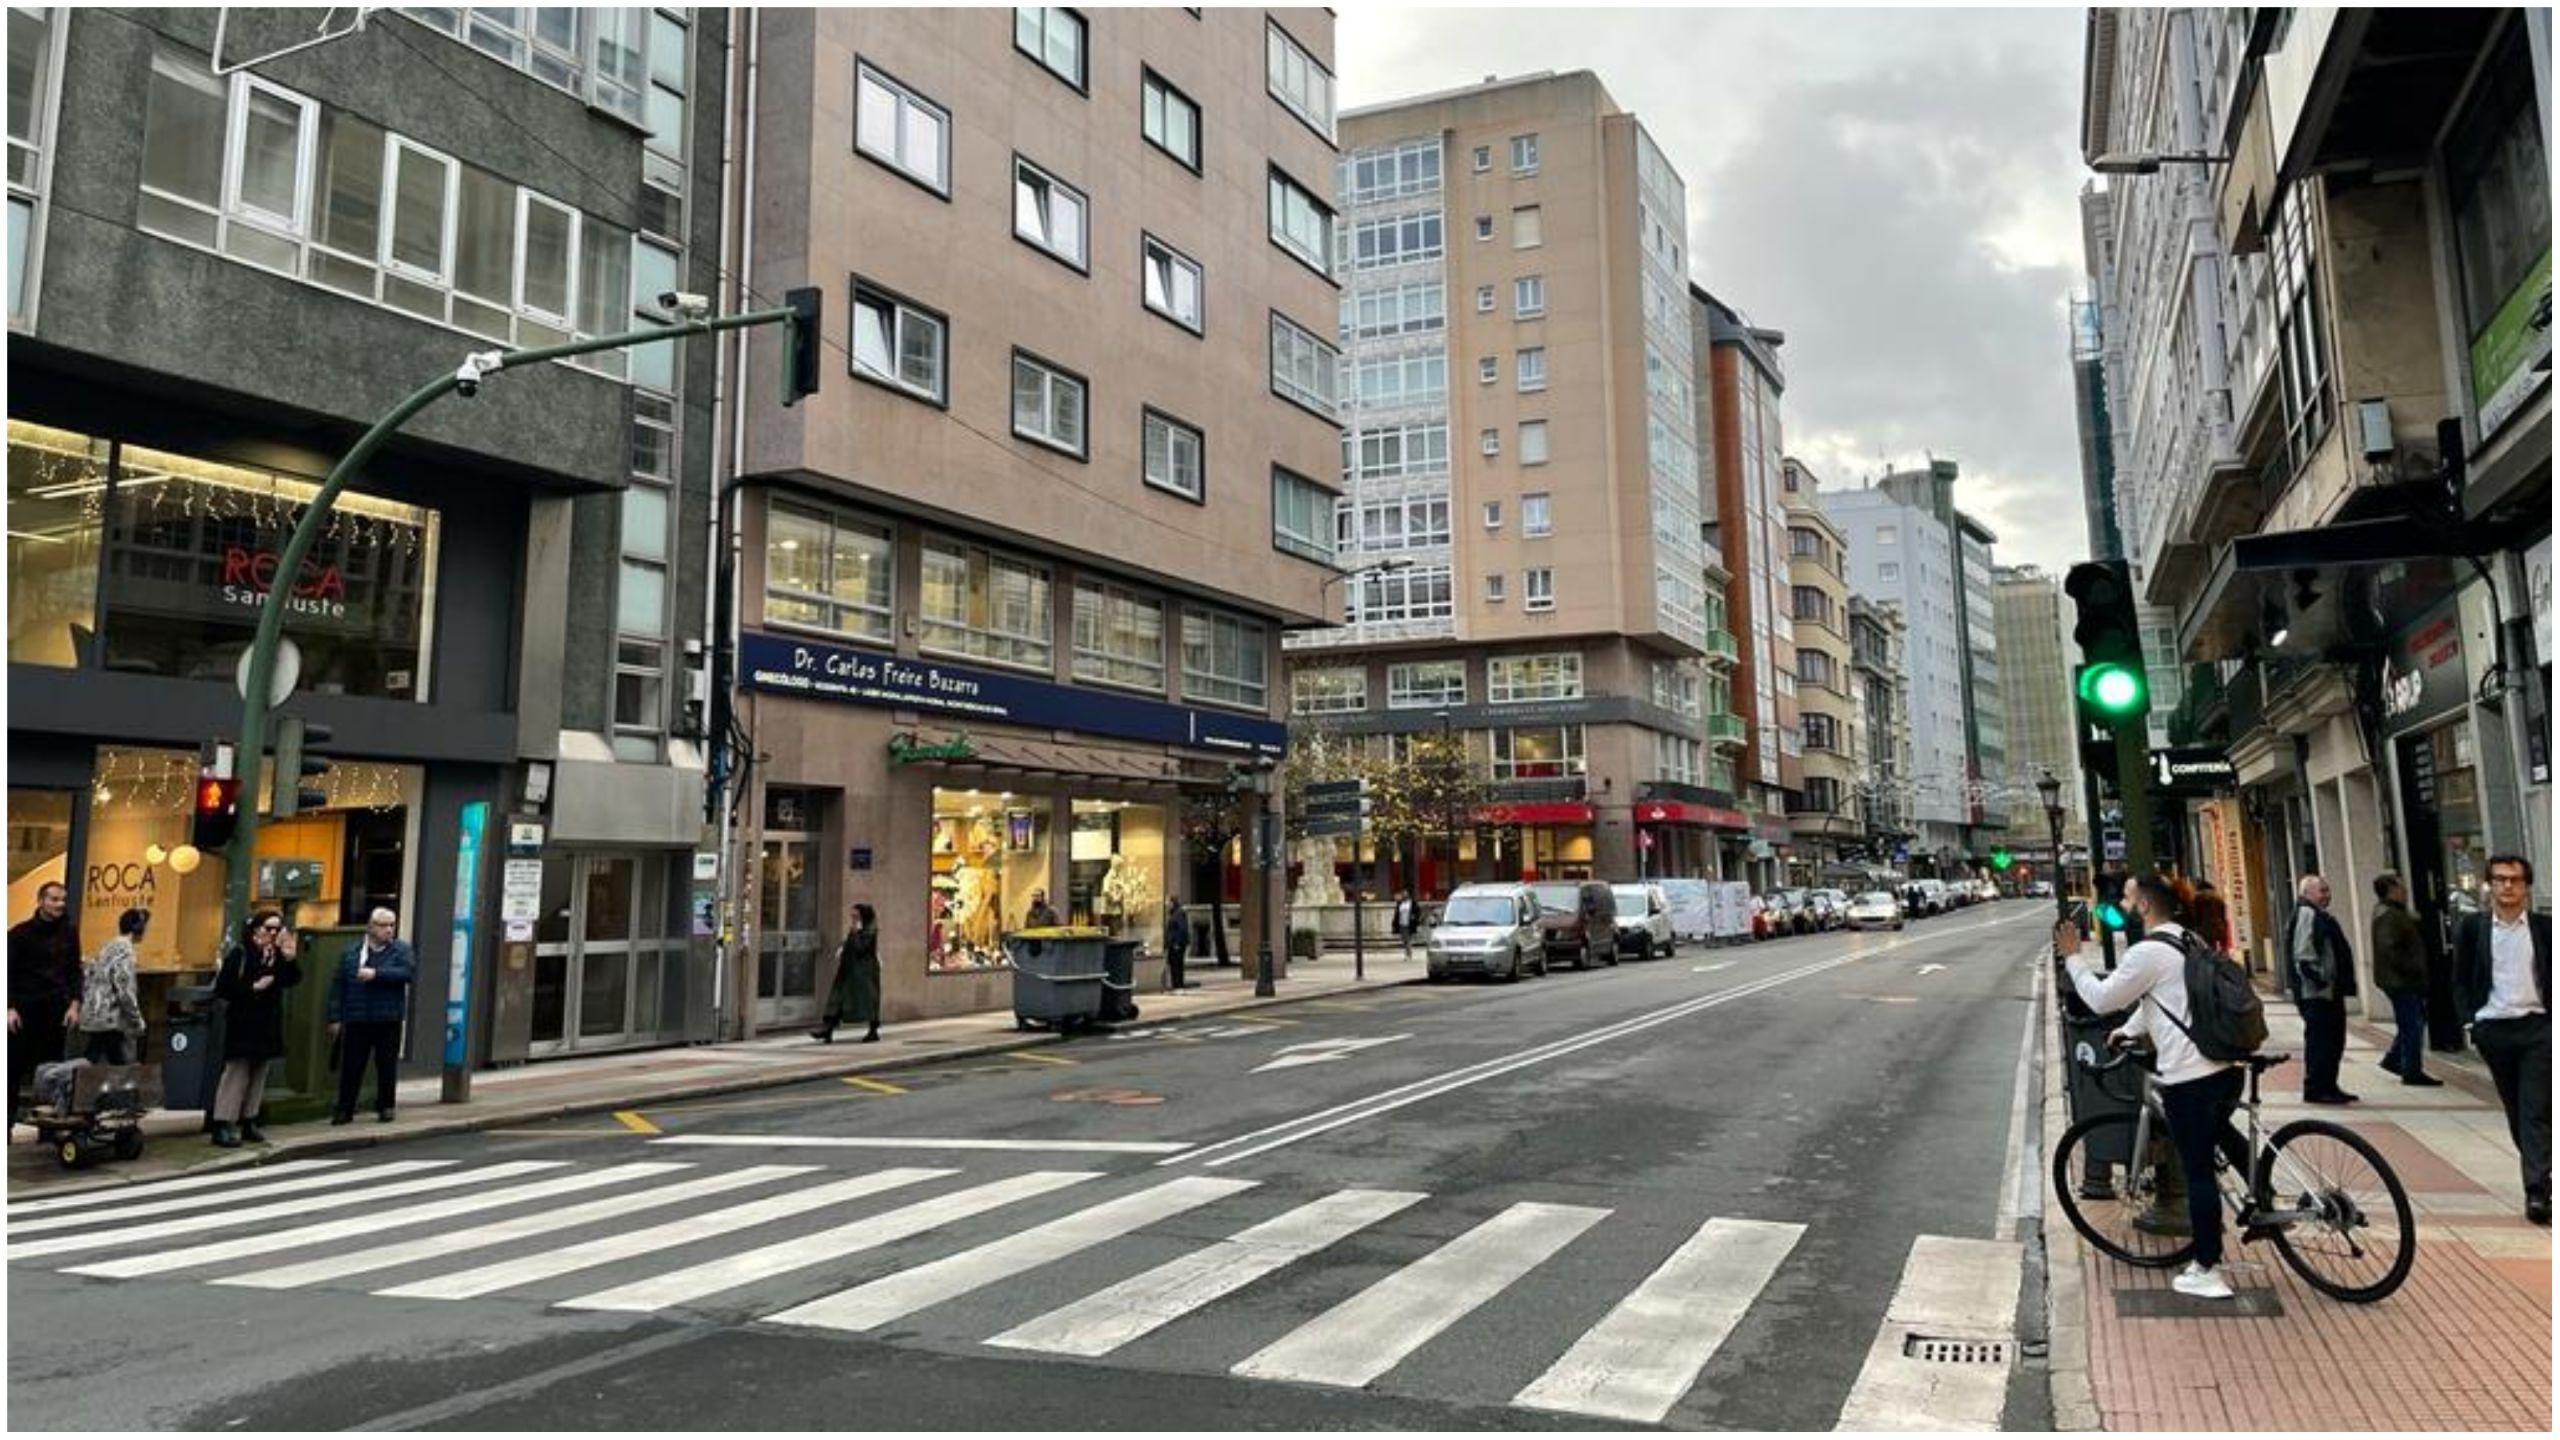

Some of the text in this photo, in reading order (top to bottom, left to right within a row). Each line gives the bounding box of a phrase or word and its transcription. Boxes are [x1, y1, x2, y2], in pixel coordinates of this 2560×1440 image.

[225, 547, 345, 599] ROCA
[794, 647, 818, 671] Dr.
[825, 654, 876, 680] Carlos
[883, 661, 923, 687] Freire
[88, 863, 156, 892] ROCA
